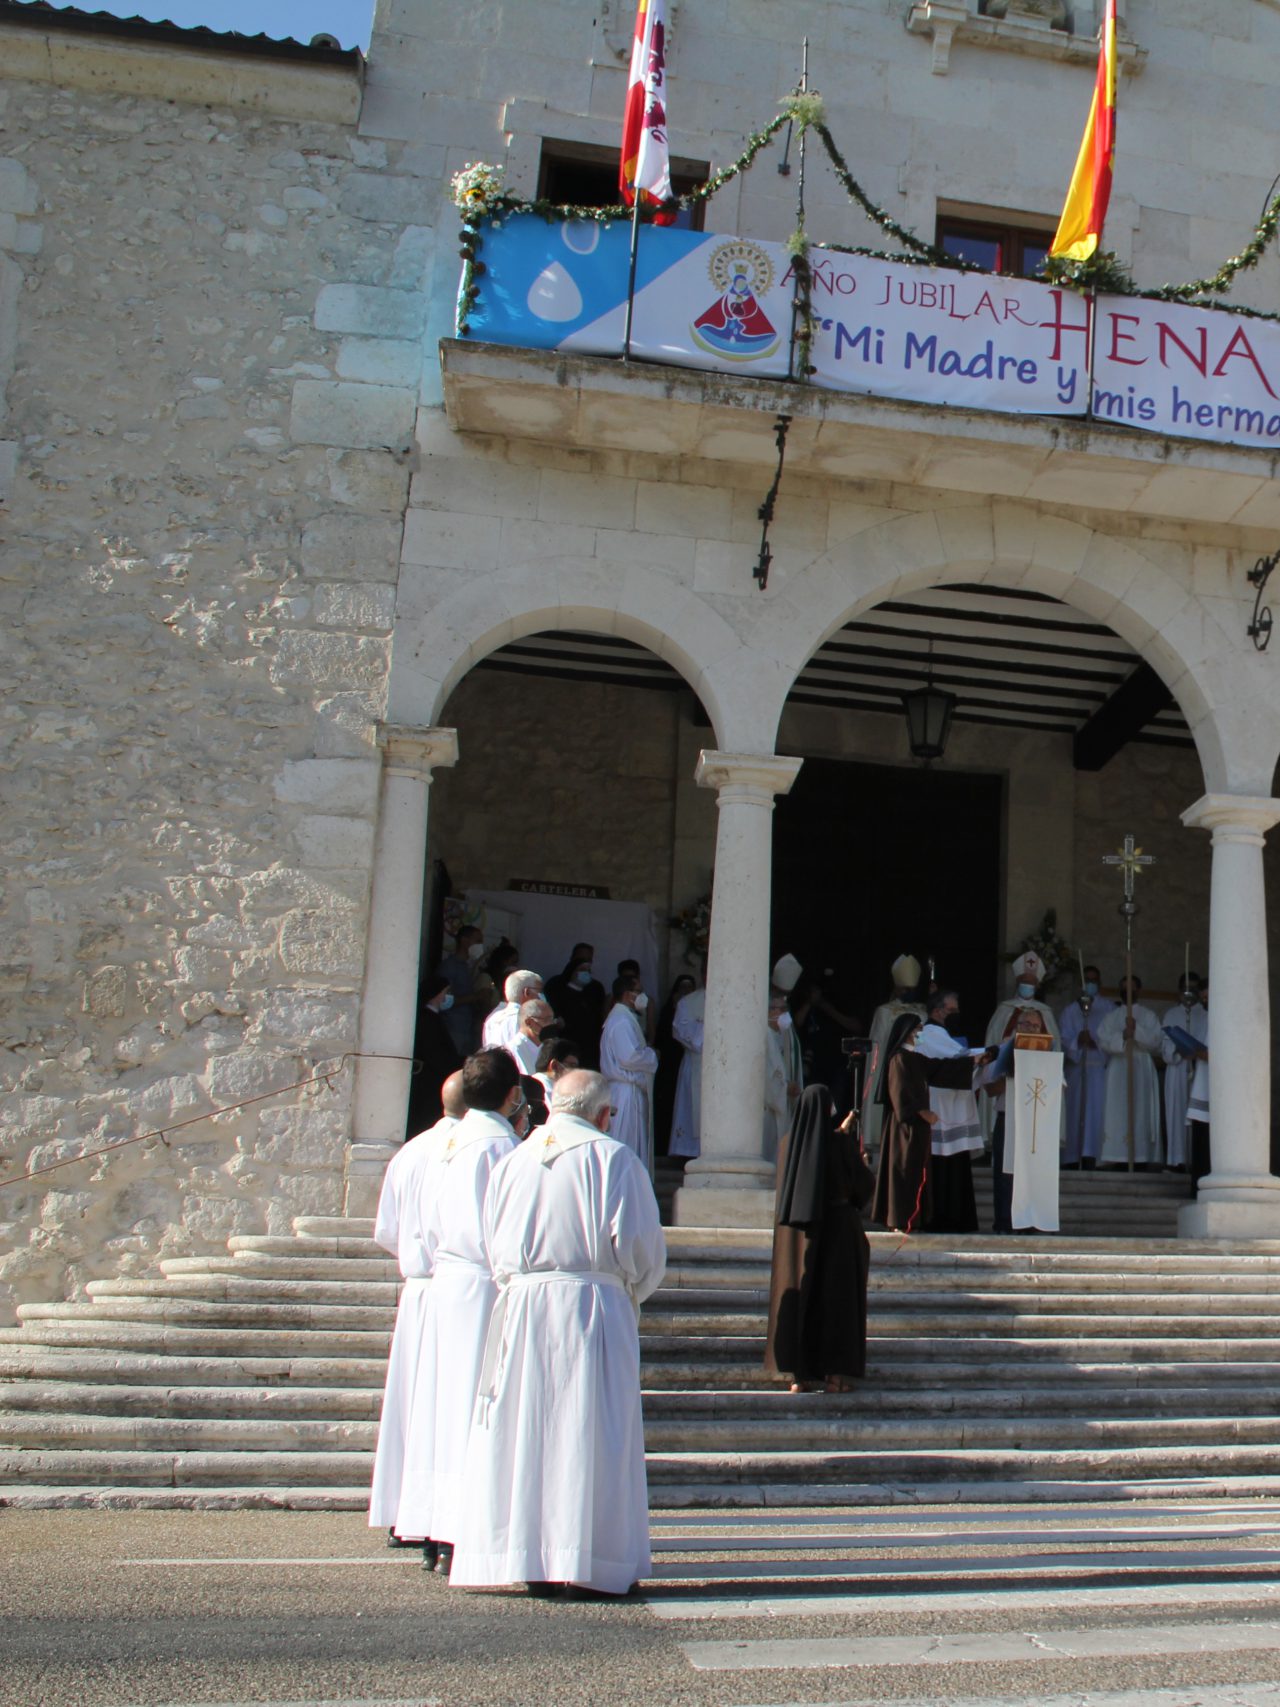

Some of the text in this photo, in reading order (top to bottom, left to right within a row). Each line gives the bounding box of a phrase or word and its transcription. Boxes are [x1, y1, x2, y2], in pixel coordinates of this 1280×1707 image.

[875, 275, 1038, 327] JUBILAR
[904, 332, 1038, 385] Madre
[1057, 366, 1077, 404] y
[1094, 386, 1157, 420] mis
[521, 883, 597, 898] CARTELERA
